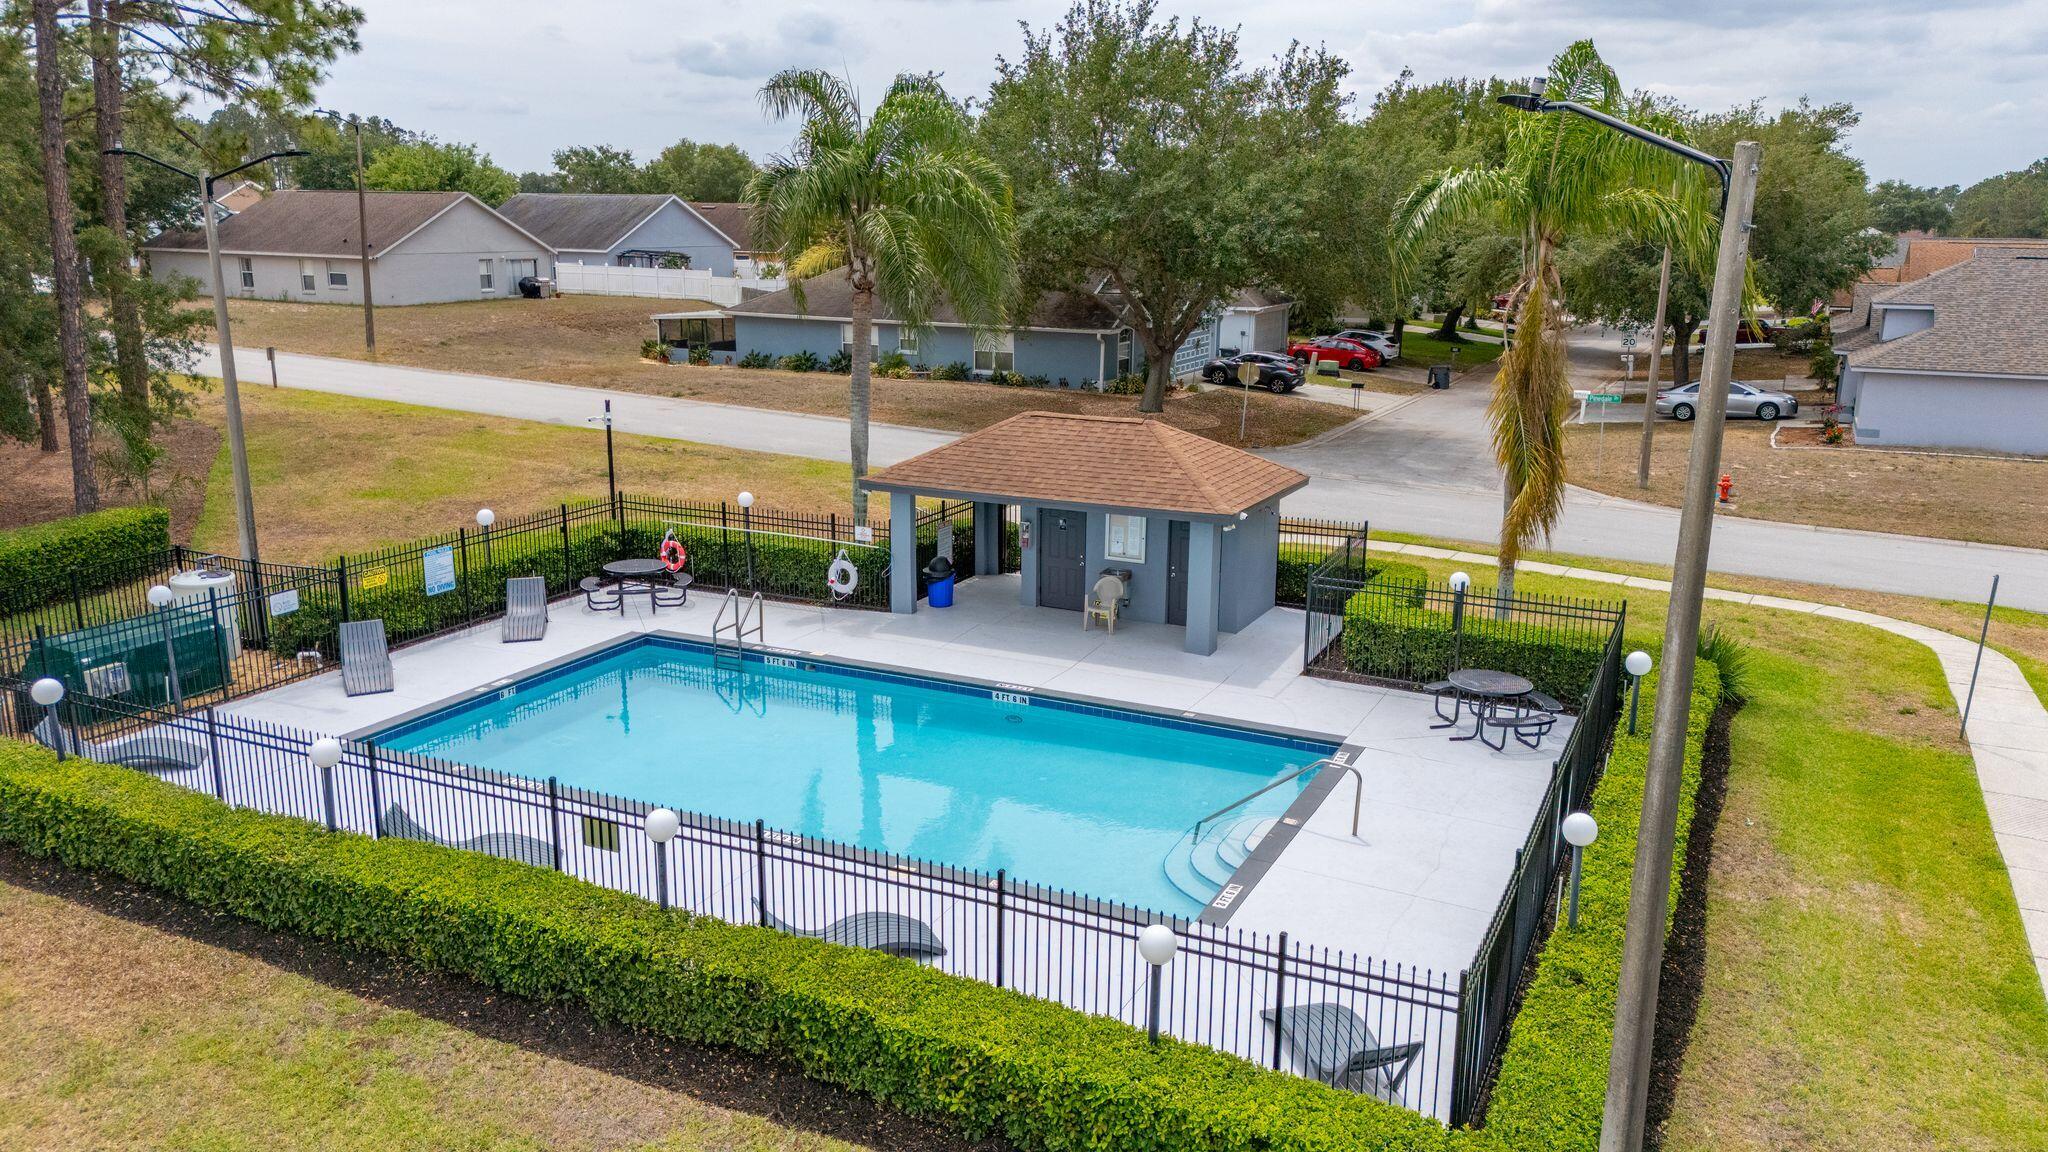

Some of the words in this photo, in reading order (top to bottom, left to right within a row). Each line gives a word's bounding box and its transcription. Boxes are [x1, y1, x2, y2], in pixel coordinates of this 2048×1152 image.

[1623, 338, 1636, 346] 20
[1590, 394, 1612, 402] Pinedale
[436, 582, 455, 592] DIVING
[787, 660, 795, 668] IN
[508, 687, 516, 695] FT
[994, 692, 1000, 700] 4
[1001, 693, 1010, 701] FT
[1019, 697, 1027, 705] IN
